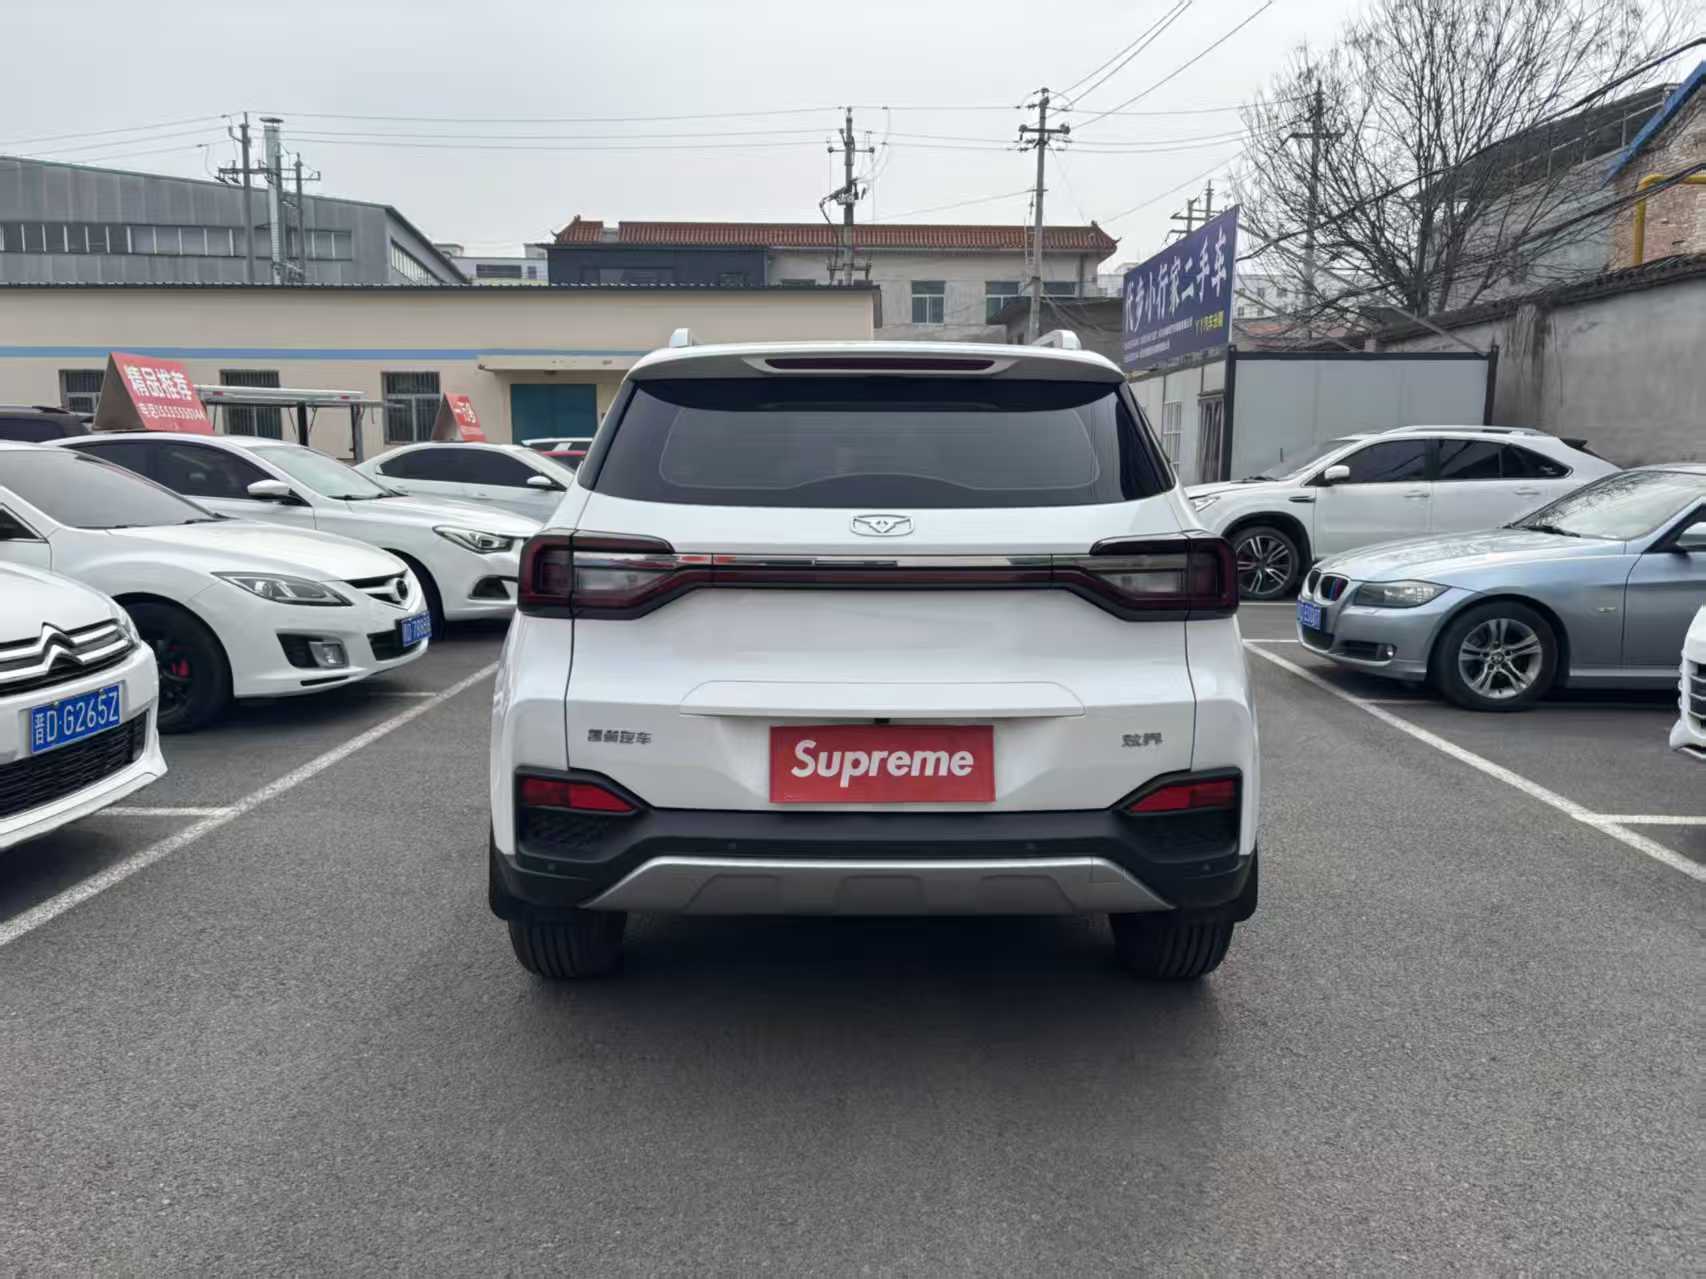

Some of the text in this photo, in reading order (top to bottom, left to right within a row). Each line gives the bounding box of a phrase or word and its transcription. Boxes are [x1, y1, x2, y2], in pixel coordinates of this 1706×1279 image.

[123, 364, 193, 401] 精品推荐
[791, 739, 975, 788] Supreme
